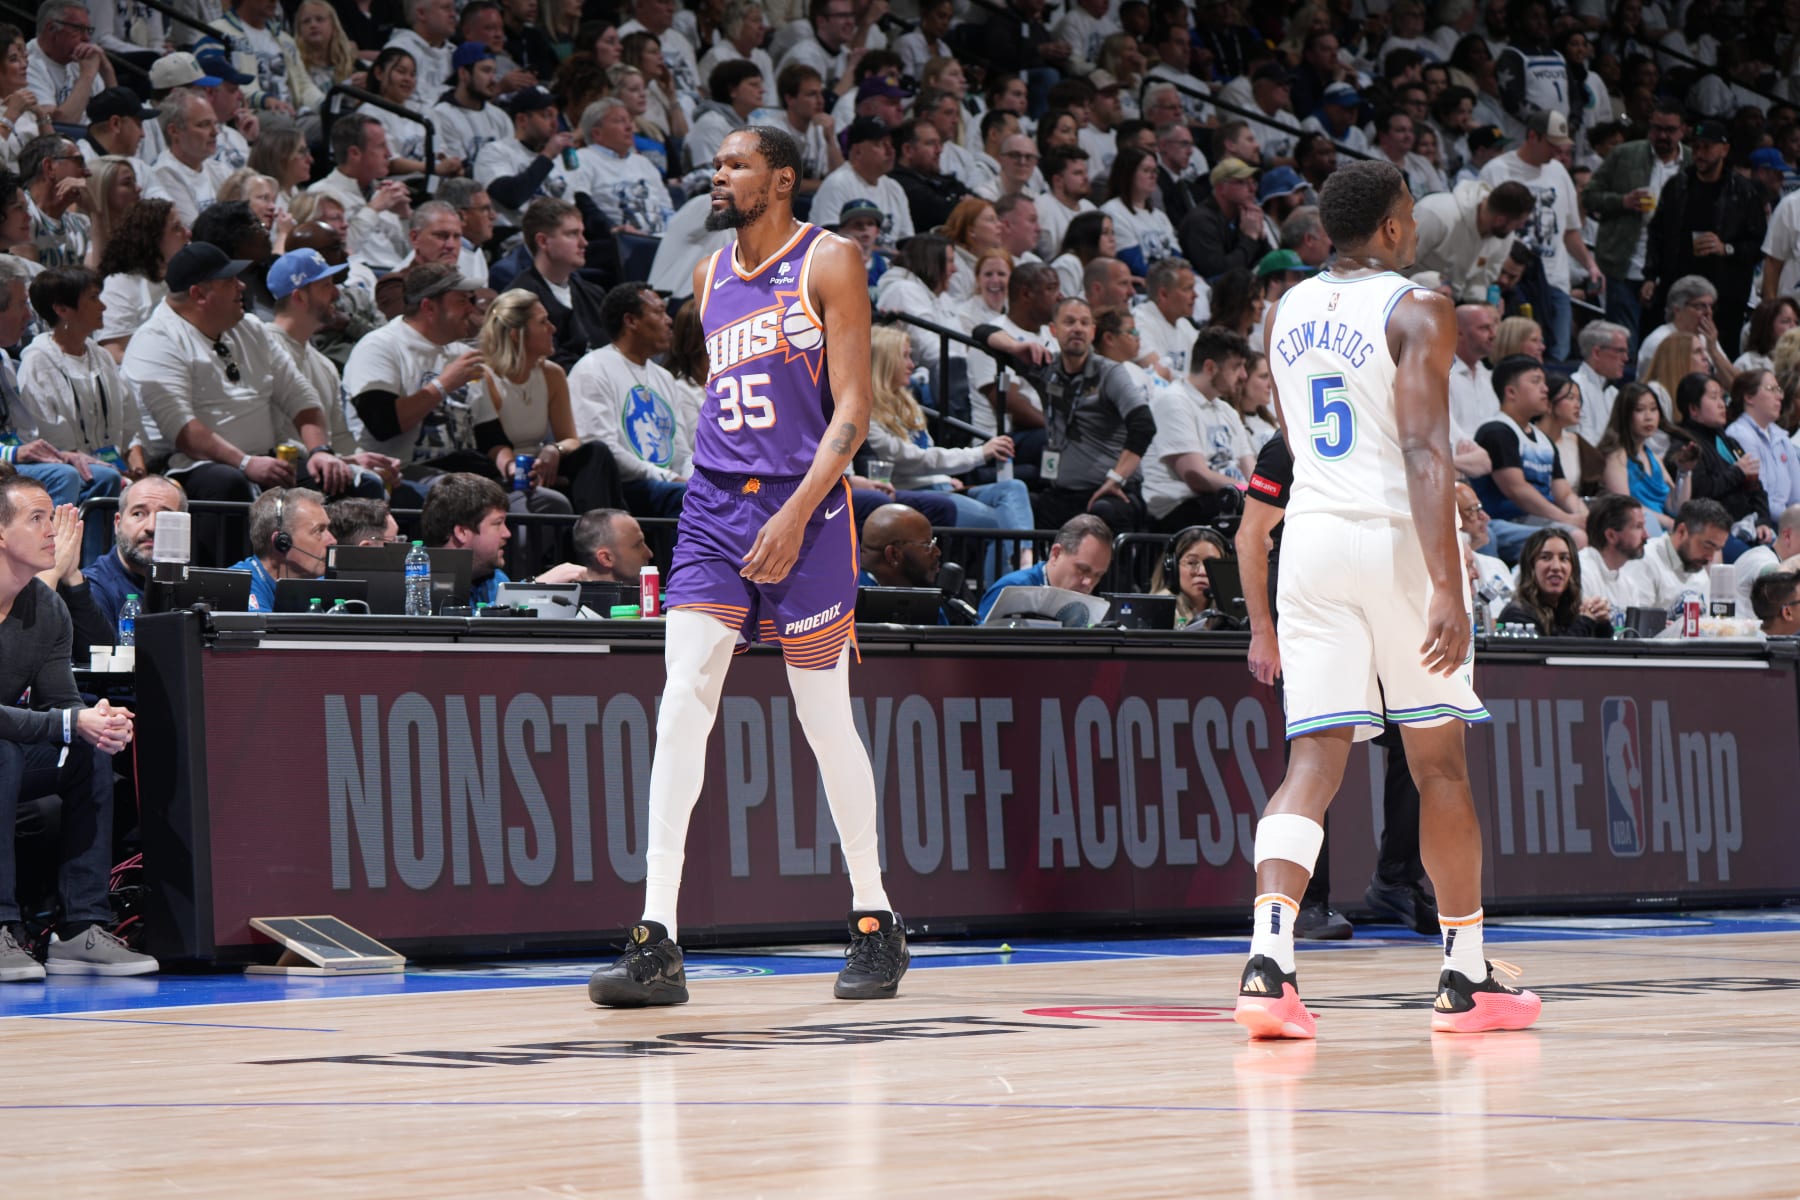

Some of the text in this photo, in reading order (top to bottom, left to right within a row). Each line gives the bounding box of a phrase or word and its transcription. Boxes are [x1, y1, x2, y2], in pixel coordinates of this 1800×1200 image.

[1552, 80, 1563, 103] 1
[769, 276, 795, 285] PayPal
[706, 312, 777, 383] UNS
[1276, 320, 1375, 369] EDWARDS
[716, 373, 777, 432] 35
[1306, 372, 1358, 463] 5
[1251, 477, 1277, 493] Emirates
[784, 601, 842, 635] PHOENIX
[324, 691, 663, 890] NONSTO
[1038, 695, 1270, 870] ACCESS
[1484, 698, 1593, 855] THE
[1651, 700, 1742, 882] App
[1612, 820, 1632, 846] NBA
[237, 1015, 1100, 1069] TARGET
